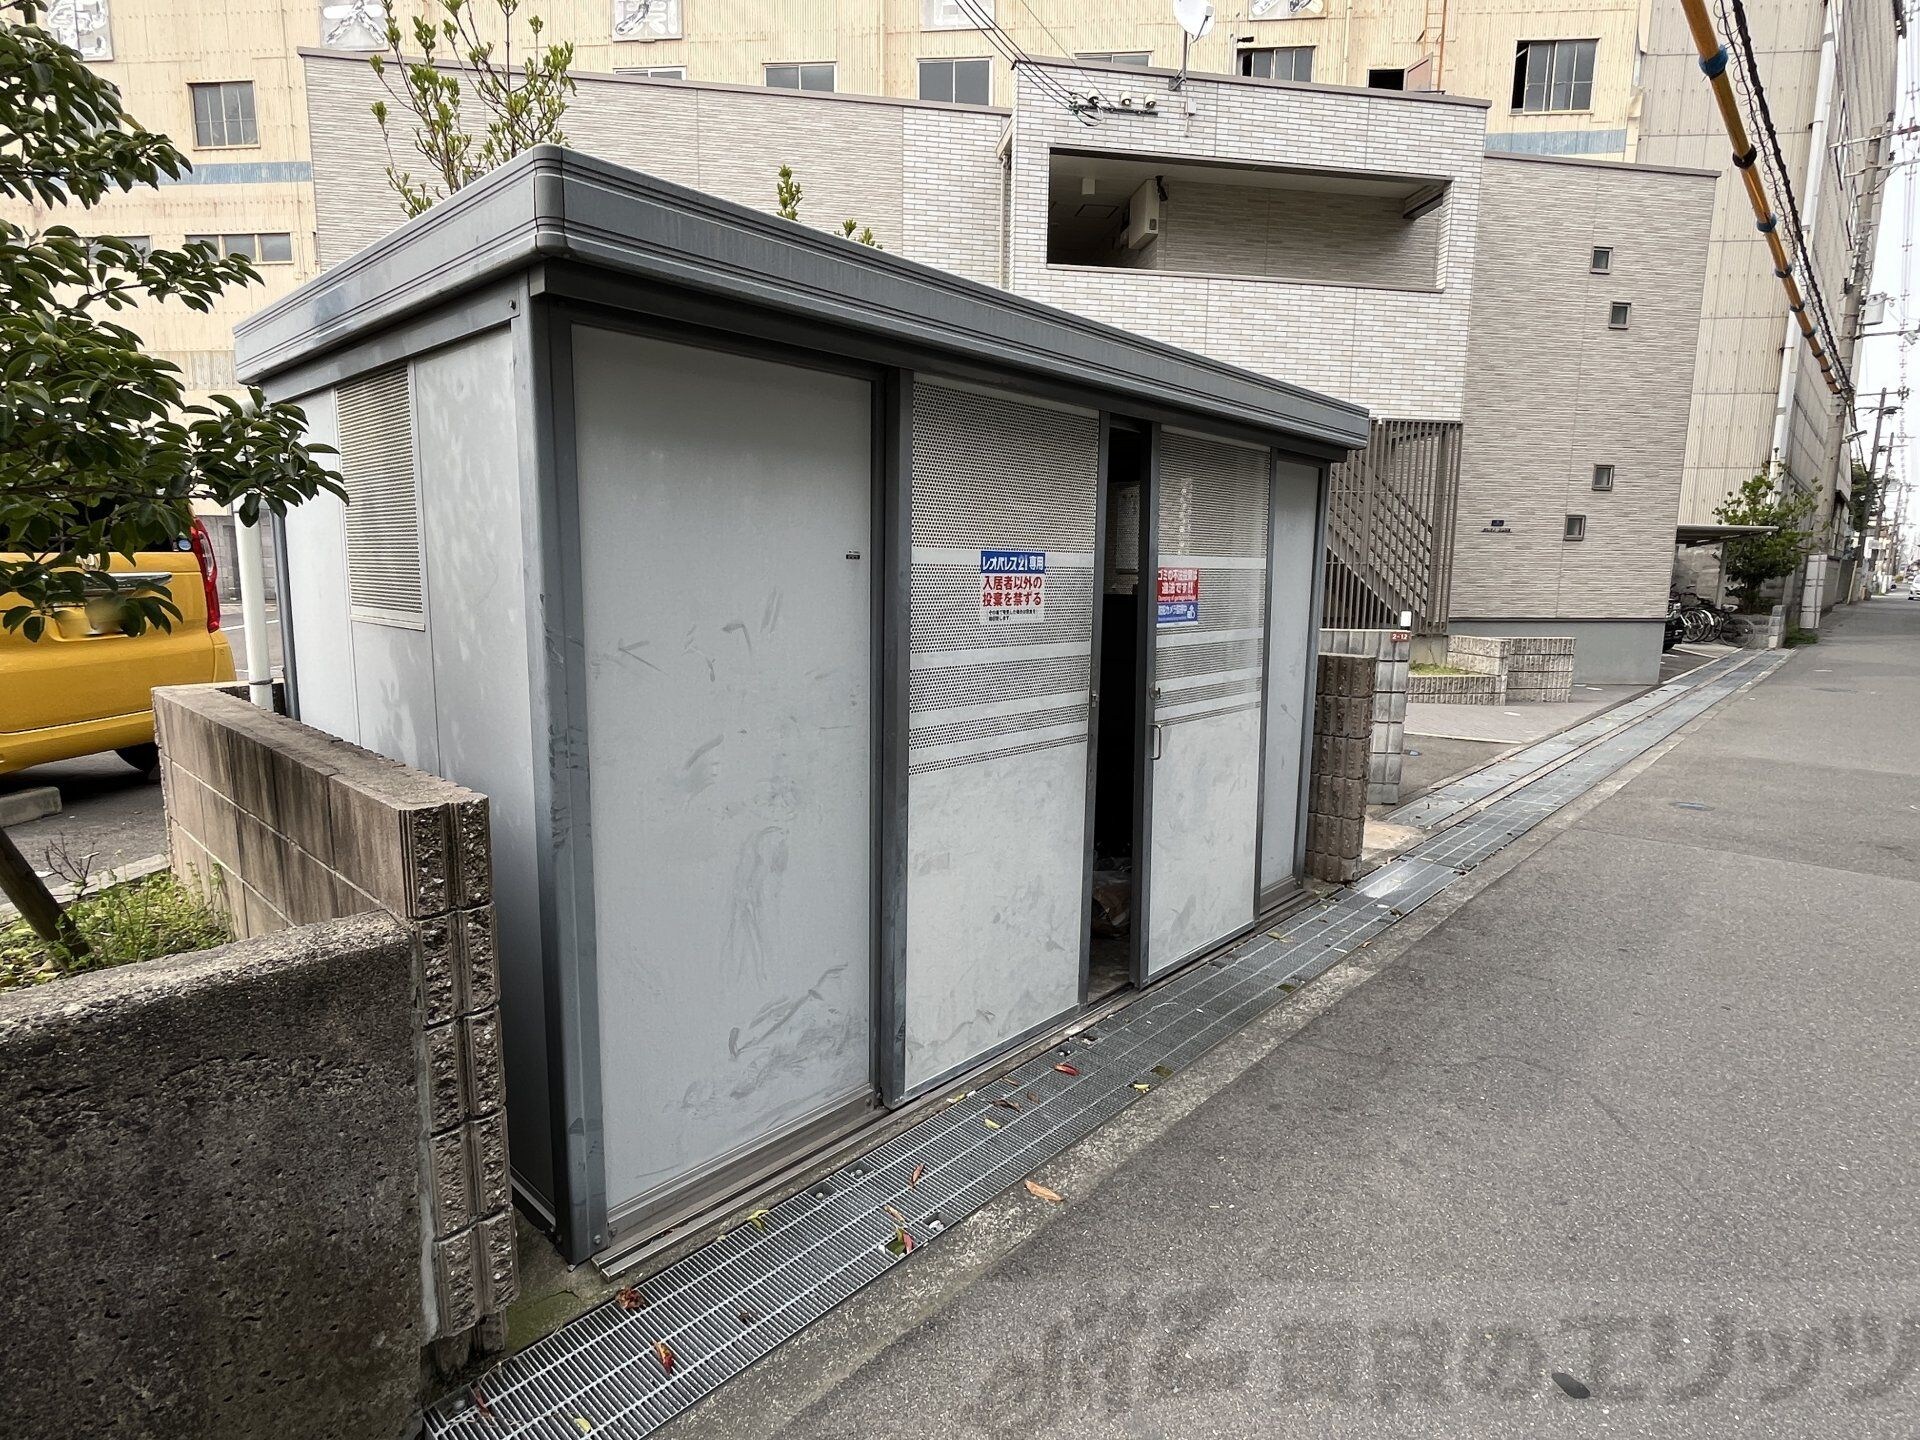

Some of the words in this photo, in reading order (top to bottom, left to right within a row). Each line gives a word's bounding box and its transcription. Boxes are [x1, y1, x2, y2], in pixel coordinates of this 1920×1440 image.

[982, 555, 1044, 571] レオパレス21専用
[983, 575, 1042, 591] 入居者以外の
